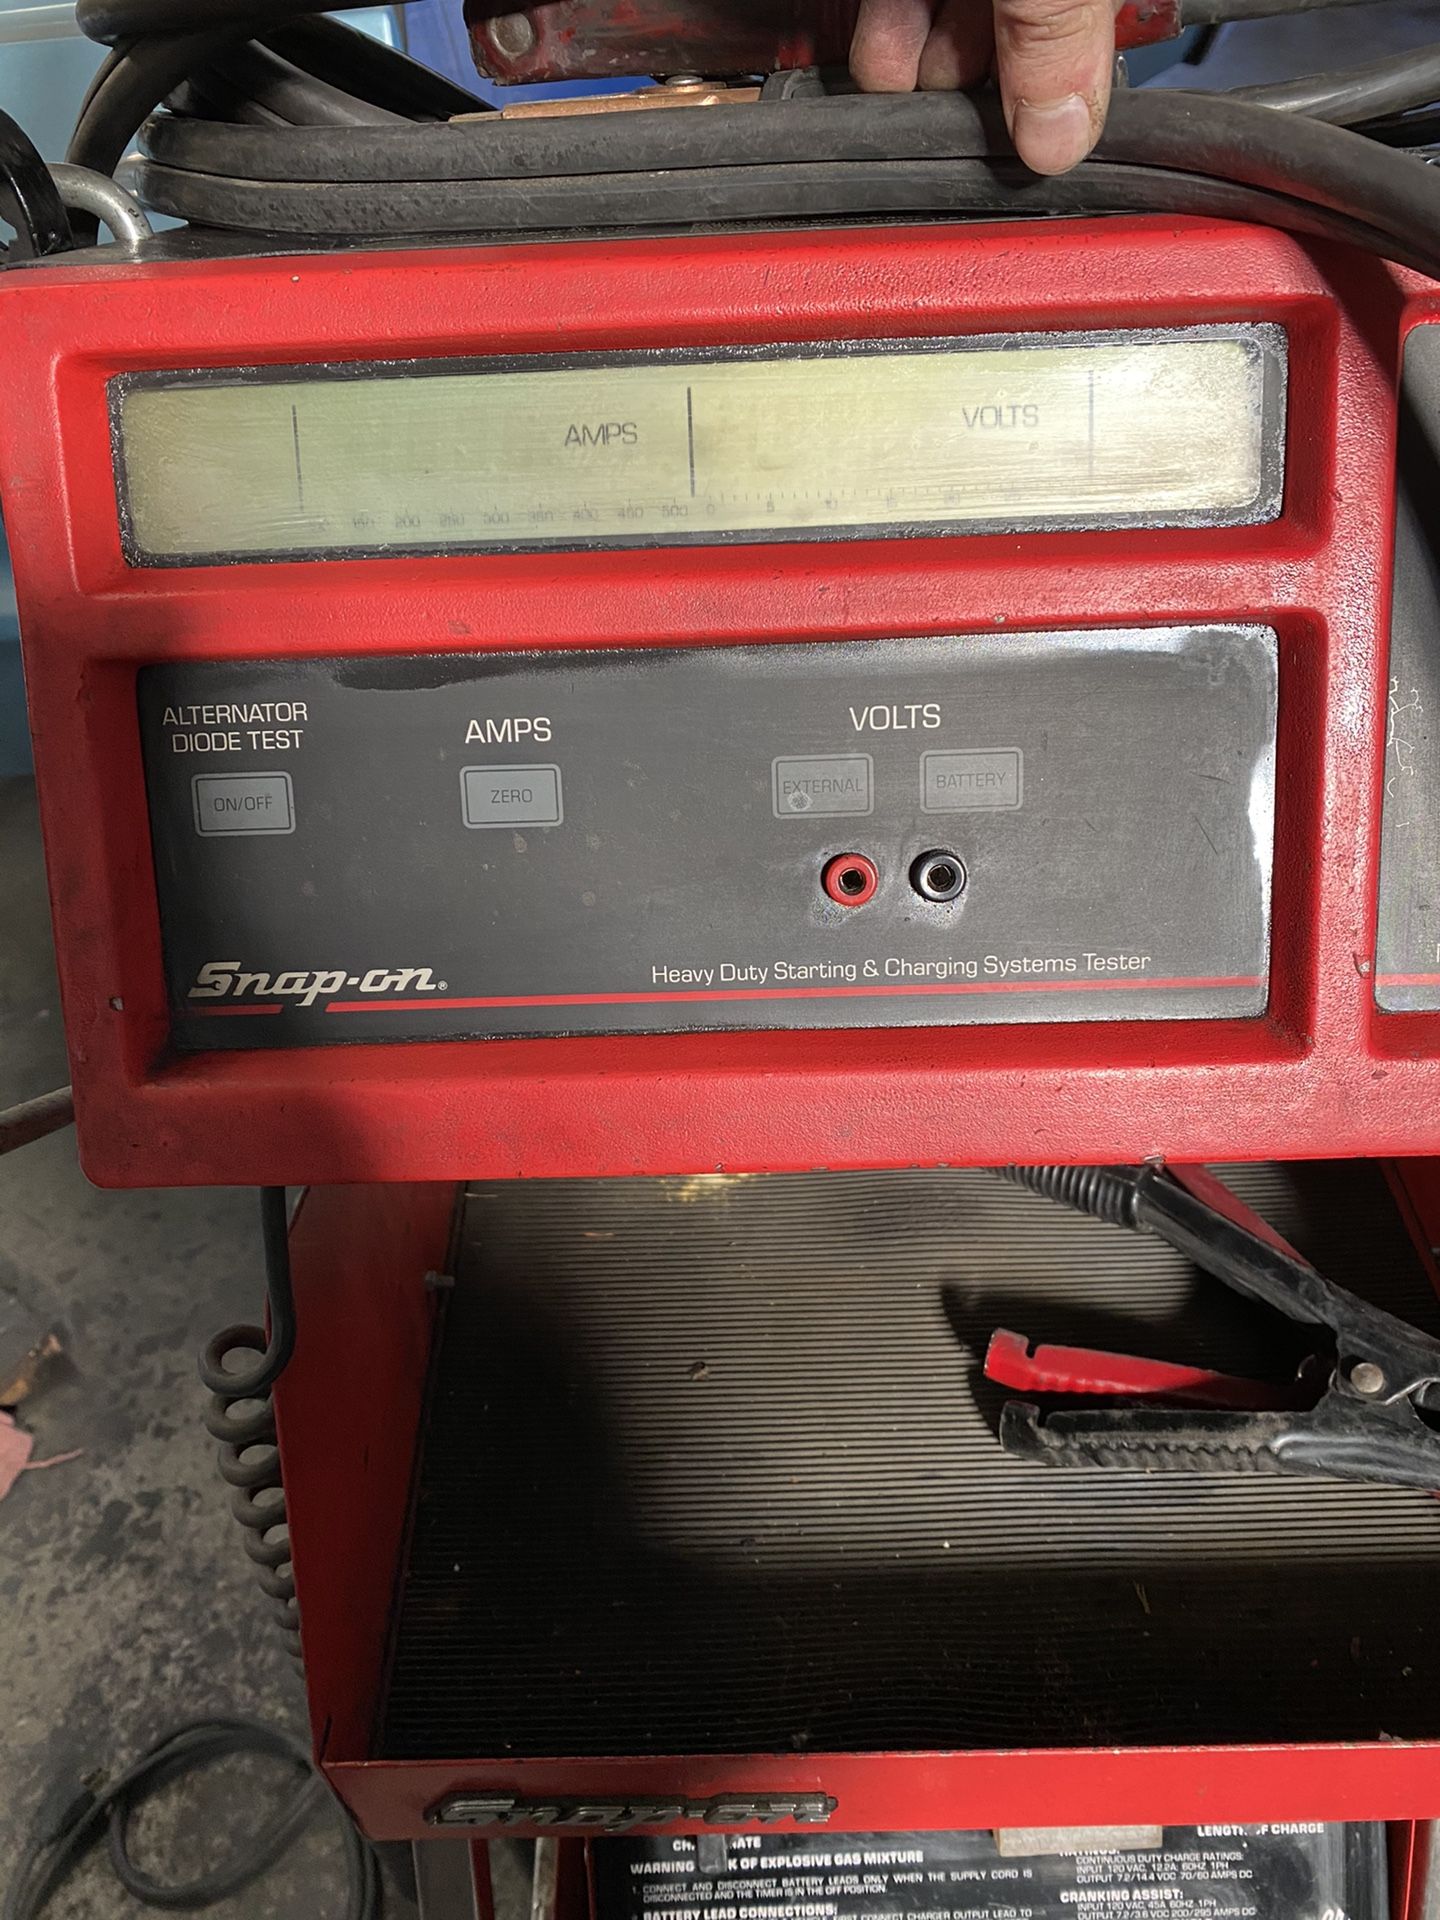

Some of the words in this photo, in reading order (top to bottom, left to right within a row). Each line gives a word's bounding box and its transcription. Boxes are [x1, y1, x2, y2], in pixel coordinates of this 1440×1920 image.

[962, 405, 1039, 429] VOLTS
[564, 424, 639, 447] AMPS
[662, 504, 688, 518] 500
[162, 701, 308, 726] ALTERNATOR
[849, 704, 941, 731] VOLTS
[465, 717, 552, 744] AMPS
[172, 730, 242, 753] DIODE
[247, 729, 304, 750] TEST
[782, 776, 864, 795] EXTERNAL
[935, 771, 1007, 789] BATTERY
[213, 794, 273, 813] ON/OFF
[491, 788, 533, 805] ZERO
[651, 964, 714, 985] Heavy
[719, 962, 768, 983] Duty
[773, 960, 857, 982] Starting
[863, 959, 879, 976] &
[884, 957, 978, 979] Charging
[983, 955, 1077, 976] Systems
[1082, 952, 1151, 972] Tester
[424, 1791, 838, 1832] Snap-on
[1271, 1822, 1325, 1835] CHARGE
[630, 1860, 695, 1875] WARNING
[740, 1857, 757, 1871] OF
[760, 1853, 832, 1869] EXPLOSIVE
[834, 1851, 861, 1866] GAS
[863, 1849, 924, 1865] MIXTURE
[1075, 1854, 1136, 1865] CONTINUOUS
[1137, 1853, 1161, 1864] DUTY
[1163, 1852, 1200, 1862] CHARGE
[1076, 1864, 1103, 1874] INPUT
[1107, 1863, 1125, 1873] 120
[1076, 1873, 1113, 1884] OUTPUT
[1157, 1871, 1176, 1881] VDC
[1210, 1870, 1237, 1879] AMPS
[1239, 1869, 1253, 1879] DC
[642, 1882, 687, 1894] CONNECT
[692, 1881, 713, 1892] AND
[717, 1878, 777, 1891] DISCONNECT
[782, 1876, 825, 1888] BATTERY
[828, 1874, 859, 1886] LEADS
[863, 1873, 889, 1884] ONLY
[893, 1871, 924, 1884] WHEN
[928, 1871, 946, 1882] THE
[950, 1869, 987, 1881] SUPPLY
[991, 1868, 1019, 1880] CORD
[1022, 1868, 1033, 1879] IS
[643, 1892, 713, 1904] DISCONNECTED
[714, 1890, 734, 1901] AND
[736, 1888, 753, 1900] THE
[755, 1887, 783, 1899] TIMER
[784, 1886, 794, 1897] IS
[795, 1885, 805, 1897] IN
[807, 1885, 823, 1896] THE
[1060, 1890, 1130, 1904] CRANKING
[1132, 1888, 1184, 1901] ASSIST:
[643, 1909, 701, 1920] BATTERY
[703, 1907, 737, 1920] LEAD
[953, 1909, 989, 1920] OUTPUT
[993, 1908, 1017, 1919] LEAD
[1020, 1908, 1033, 1918] TO
[1077, 1901, 1104, 1912] INPUT
[1107, 1900, 1124, 1911] 120
[1077, 1910, 1114, 1920] OUTPUT
[1150, 1908, 1170, 1918] VDC
[1213, 1907, 1240, 1917] AMPS
[1241, 1906, 1257, 1916] DC
